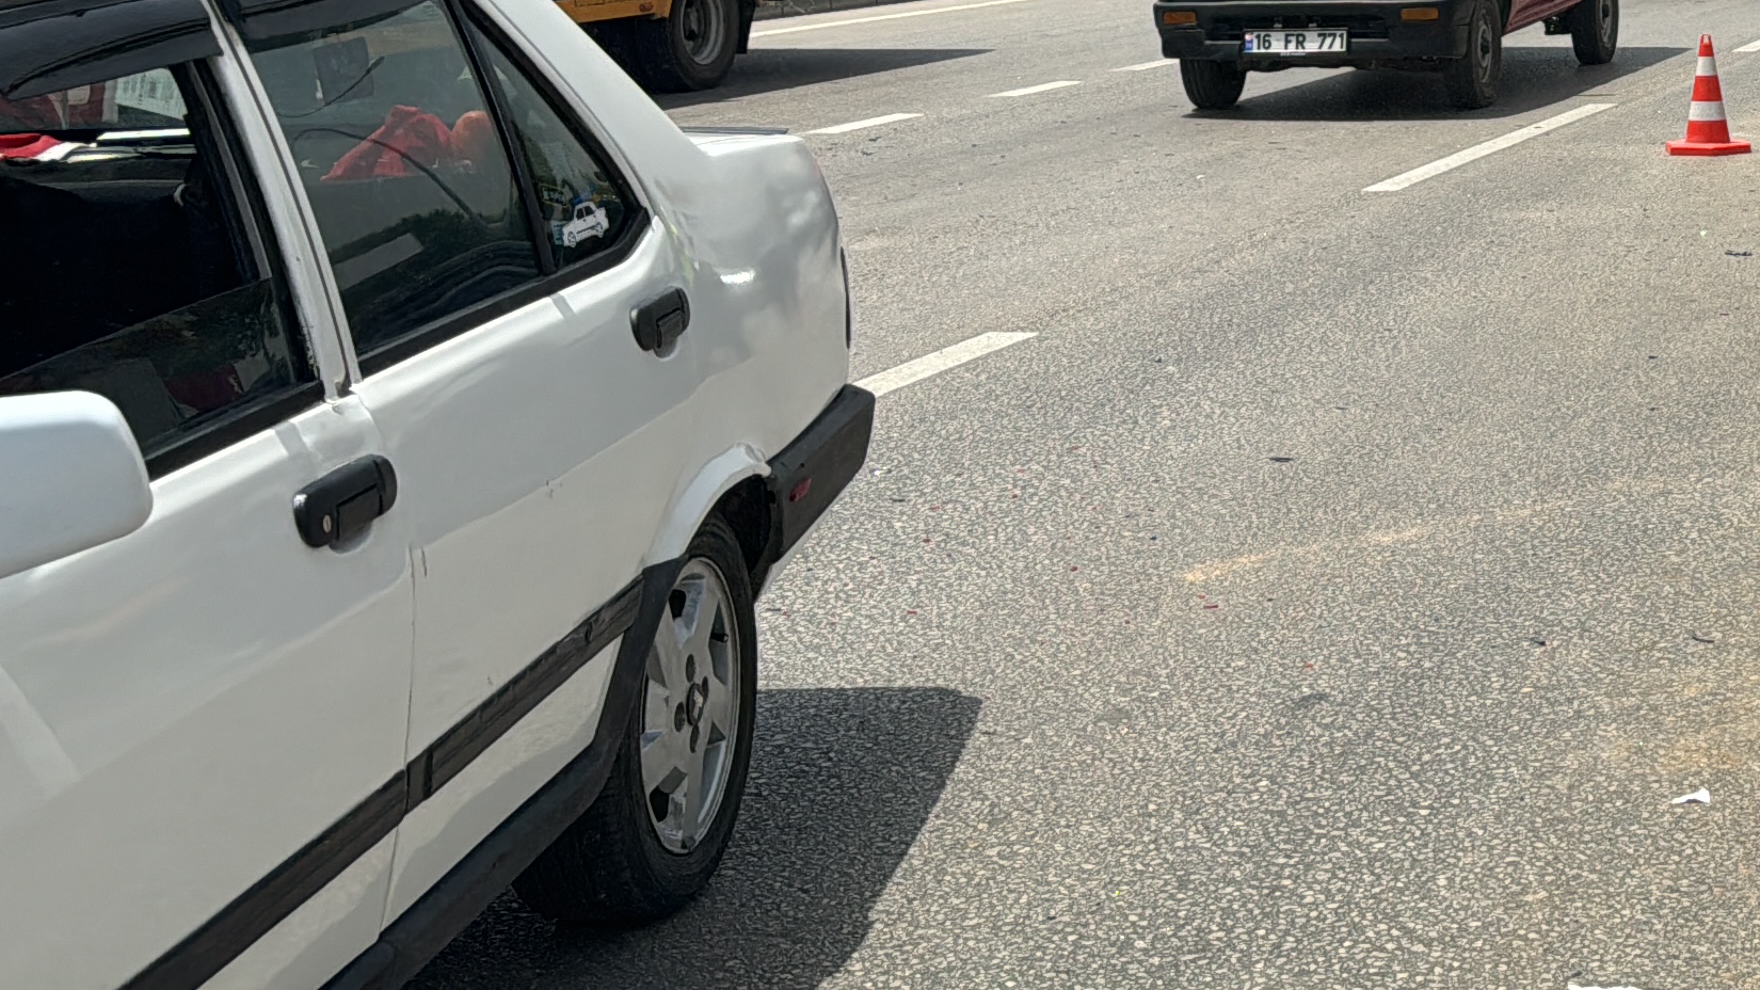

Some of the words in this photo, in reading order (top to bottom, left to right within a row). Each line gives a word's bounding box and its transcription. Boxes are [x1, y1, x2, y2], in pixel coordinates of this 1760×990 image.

[1255, 33, 1272, 50] 16
[1284, 33, 1306, 50] FR
[1317, 33, 1345, 50] 771
